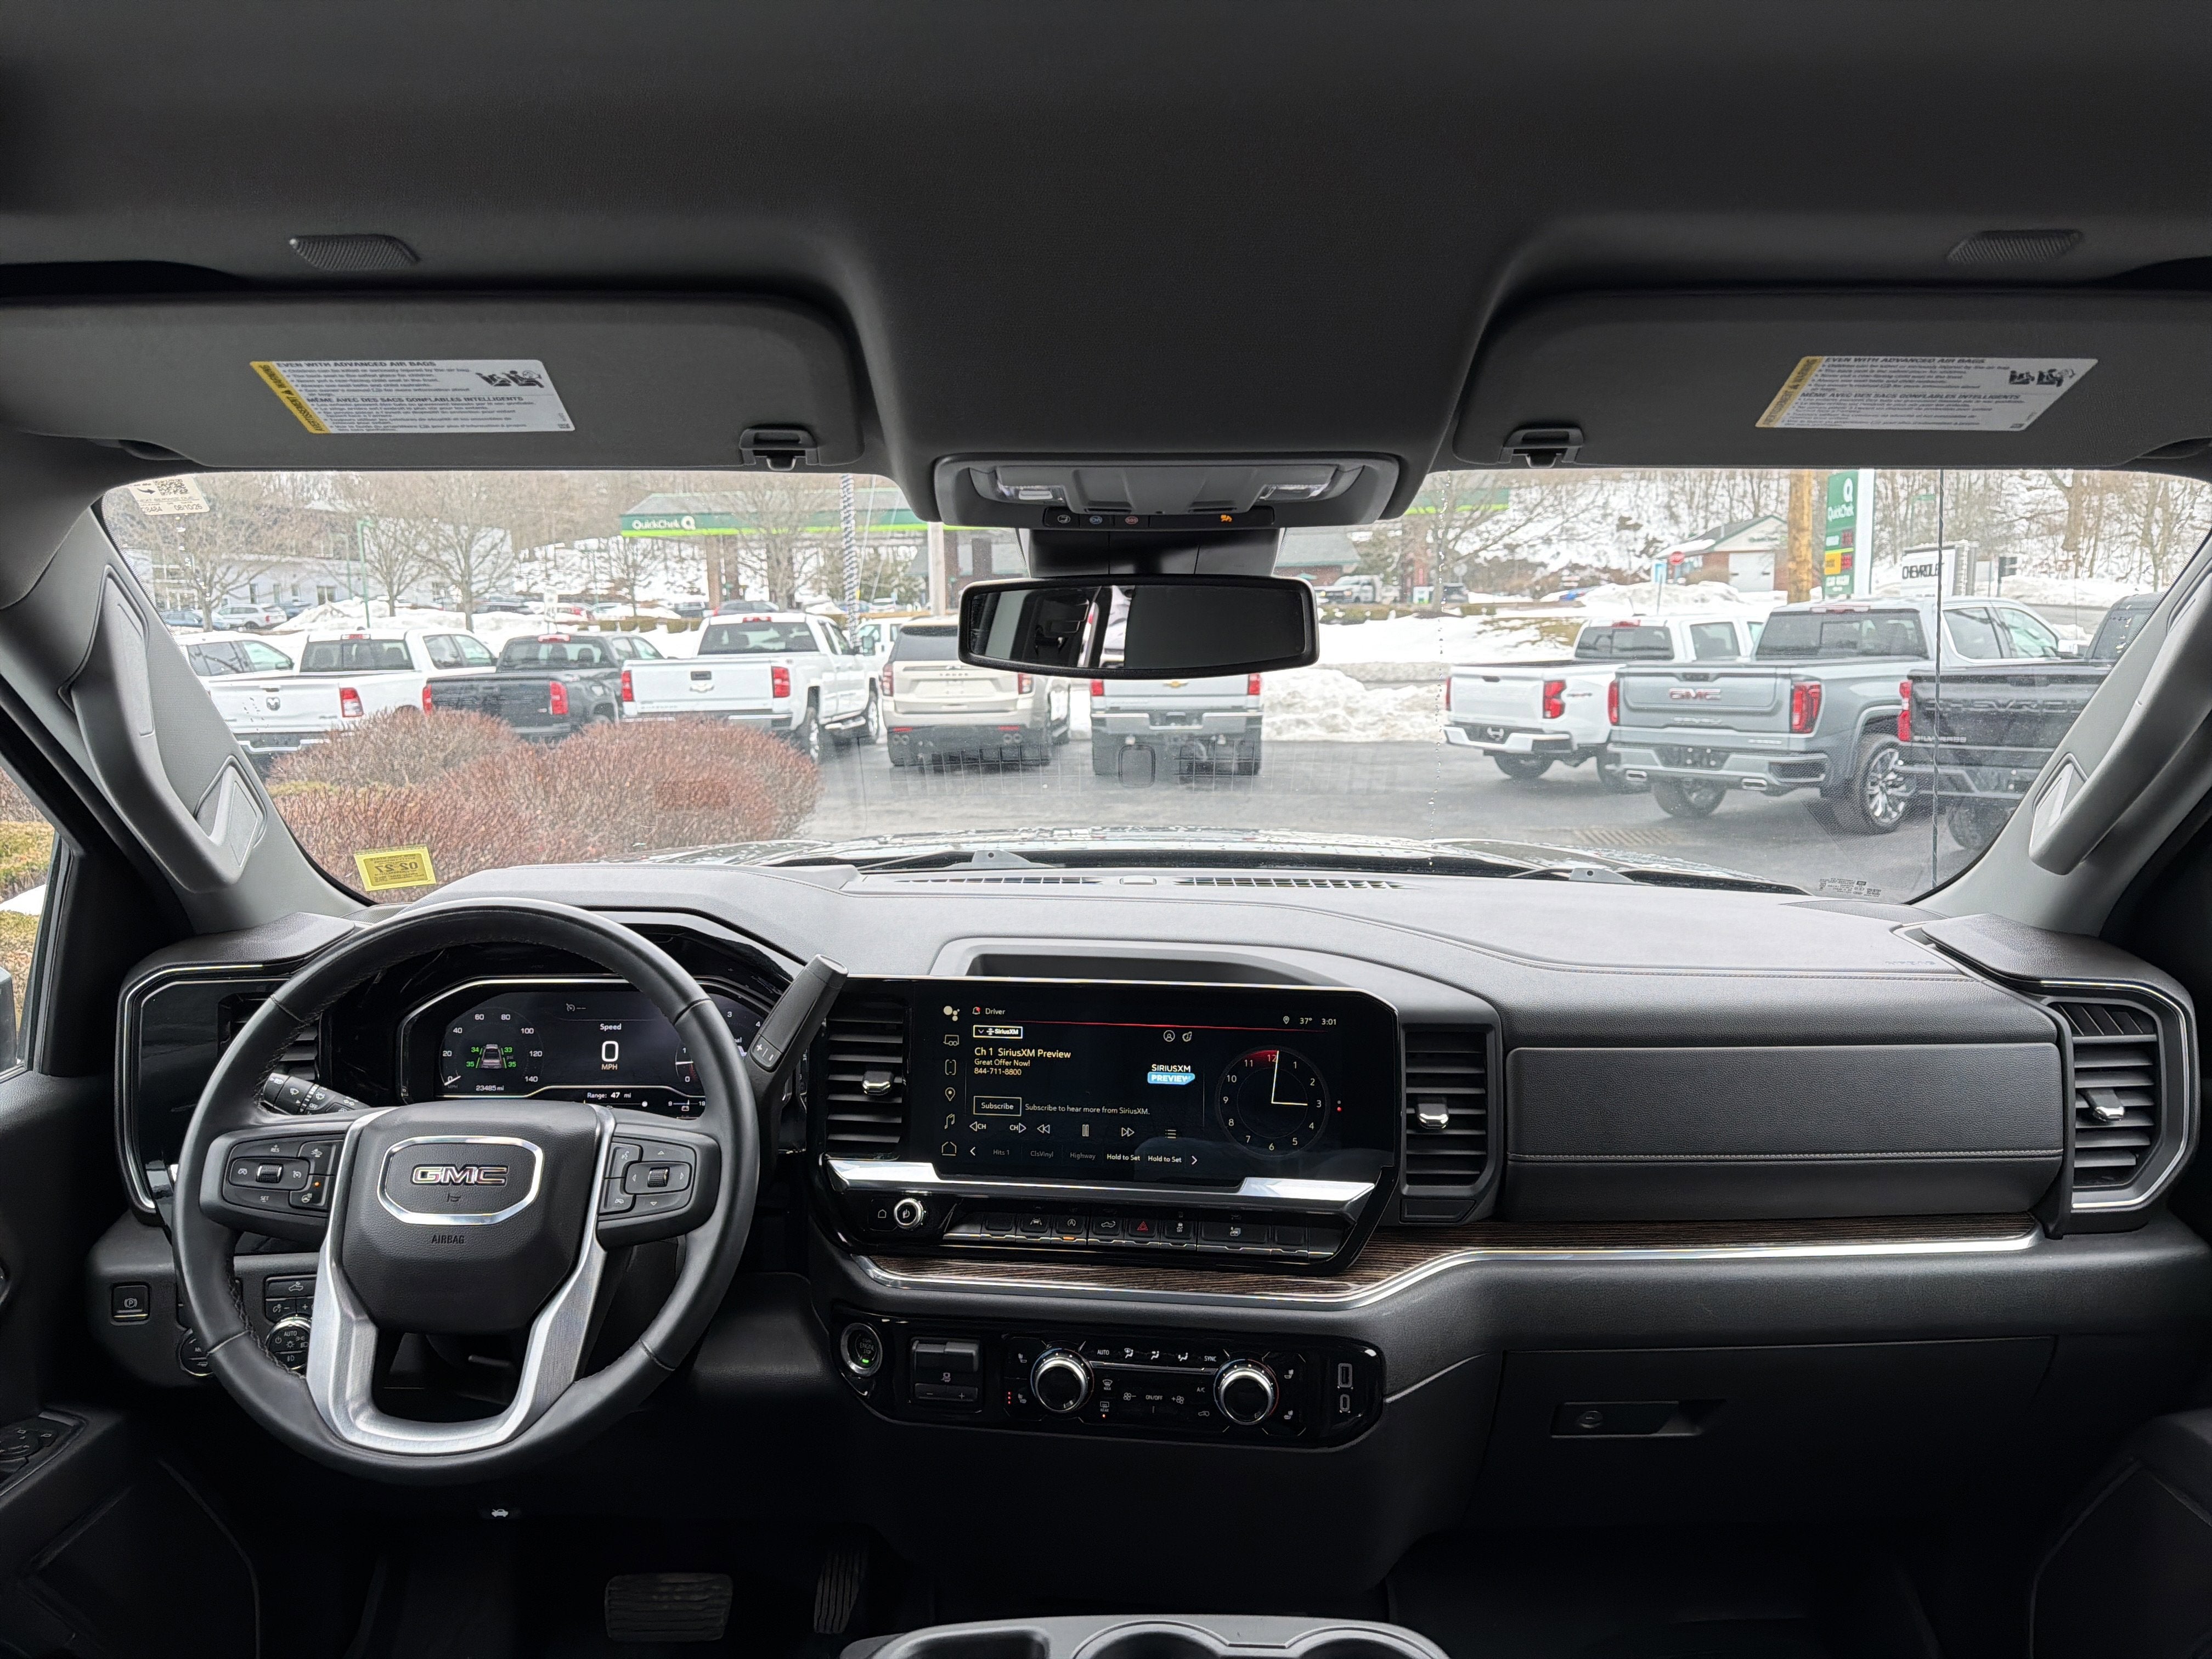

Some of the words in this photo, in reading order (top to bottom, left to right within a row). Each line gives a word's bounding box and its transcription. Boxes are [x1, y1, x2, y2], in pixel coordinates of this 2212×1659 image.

[1843, 478, 1853, 503] Q
[1827, 503, 1854, 522] QuickChek
[632, 519, 680, 529] QuickChek
[1669, 688, 1721, 700] GMC
[600, 1023, 622, 1031] Speed
[601, 1041, 619, 1062] 0
[974, 1047, 986, 1056] Ch
[989, 1047, 993, 1056] 1
[997, 1048, 1035, 1057] SiriusXM
[1037, 1049, 1071, 1058] Preview
[1267, 1054, 1277, 1062] 12
[974, 1067, 1022, 1075] 844-711-8800
[1152, 1064, 1191, 1073] SIRIUSXM
[1151, 1074, 1191, 1082] PREVIEW
[1226, 1075, 1237, 1083] 10
[1310, 1078, 1315, 1086] 2
[587, 1092, 607, 1100] Range:
[1269, 1143, 1274, 1151] 6
[1070, 1152, 1096, 1160] Highway
[411, 1165, 509, 1186] GMC
[431, 1234, 465, 1244] AIRBAG
